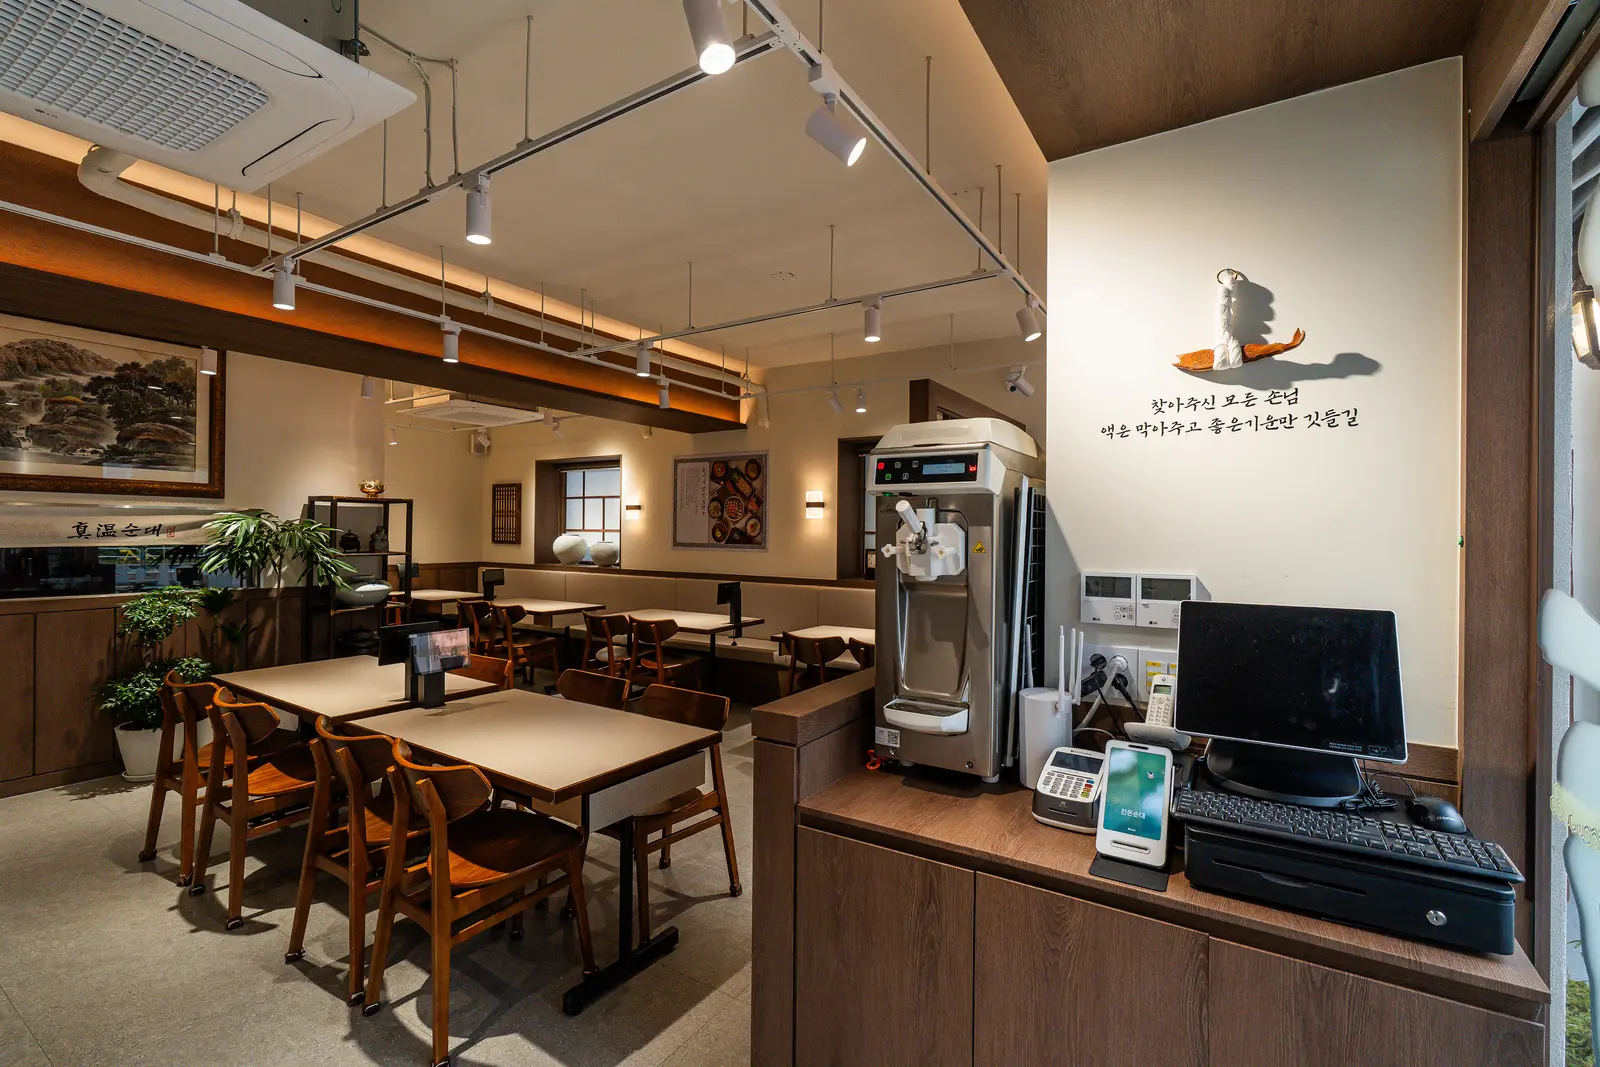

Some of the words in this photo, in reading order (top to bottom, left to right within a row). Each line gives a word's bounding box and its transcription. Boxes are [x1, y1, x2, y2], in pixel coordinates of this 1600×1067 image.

[1151, 395, 1216, 416] 찾아주신
[1221, 393, 1259, 408] 모든
[1264, 388, 1299, 406] 손님
[1100, 422, 1131, 440] 액은
[1135, 421, 1203, 438] 막아주고
[1303, 408, 1359, 429] 깃들길
